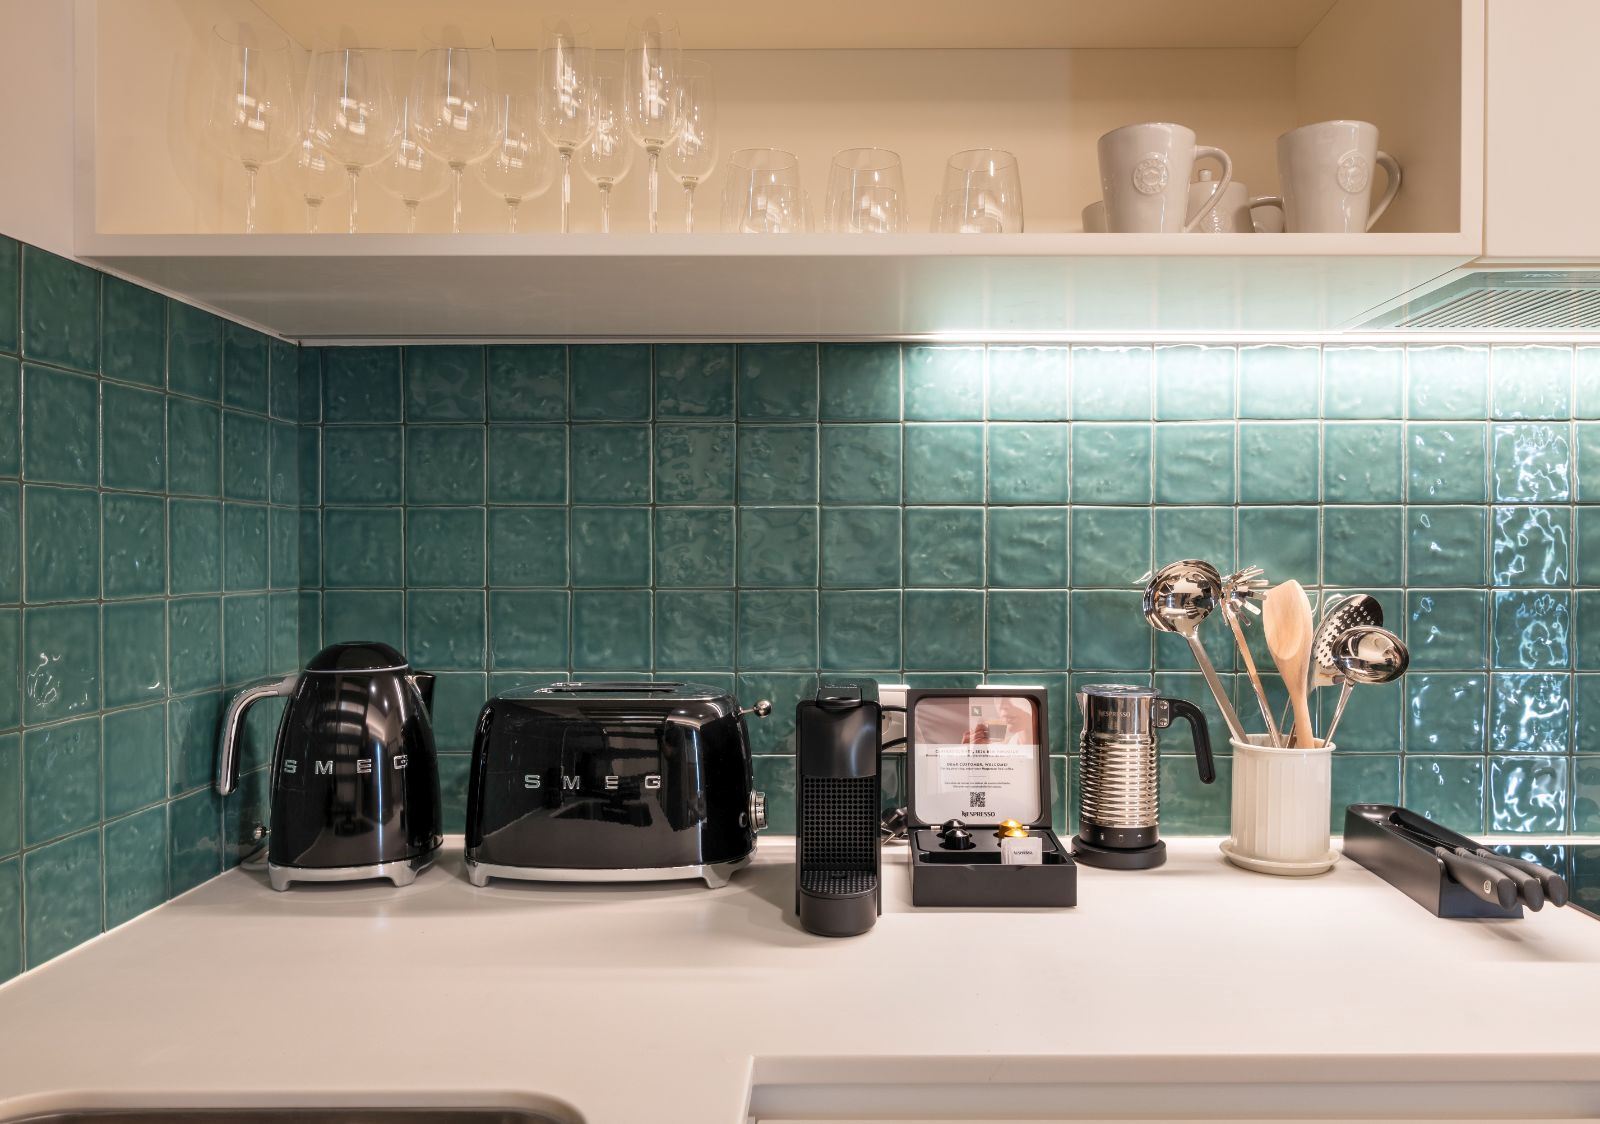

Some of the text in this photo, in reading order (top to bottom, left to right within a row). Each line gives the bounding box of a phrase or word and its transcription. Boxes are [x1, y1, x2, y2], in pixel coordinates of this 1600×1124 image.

[283, 754, 408, 775] SMEG
[524, 774, 662, 790] SMEG
[961, 810, 996, 818] NESPRESSO
